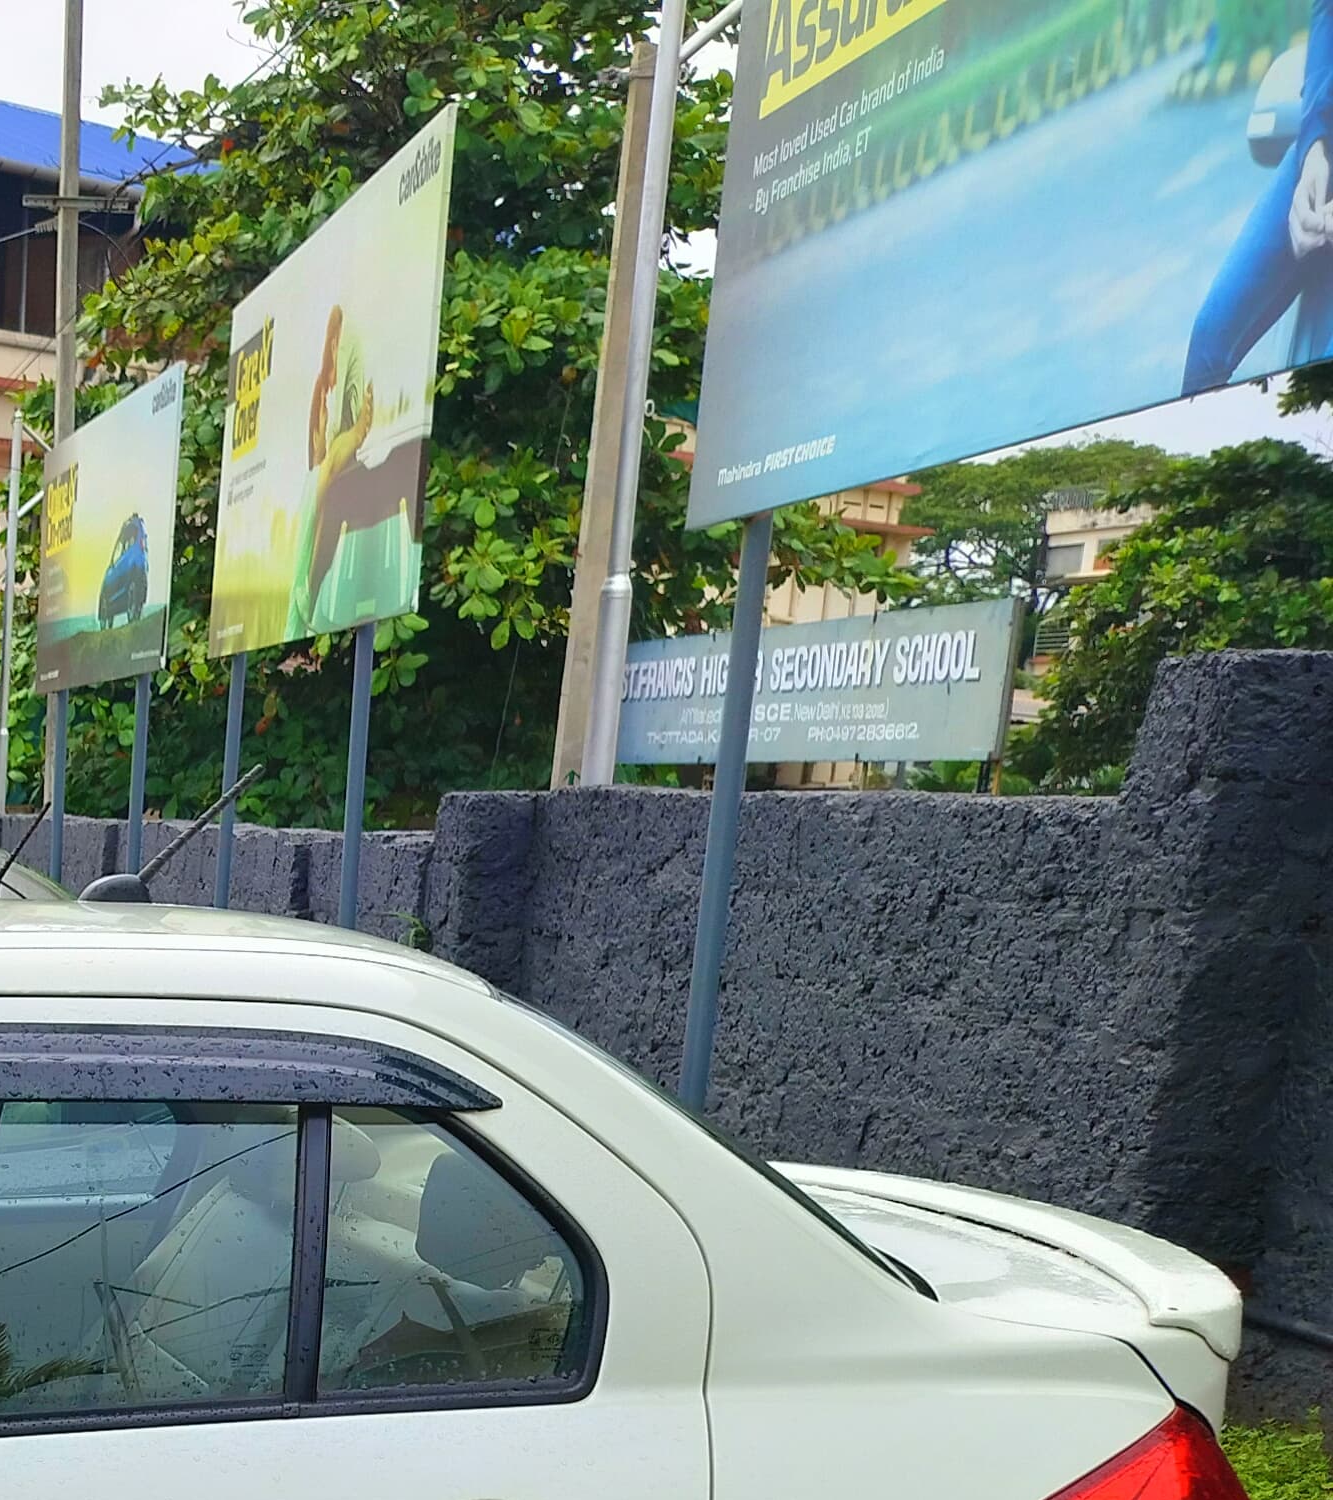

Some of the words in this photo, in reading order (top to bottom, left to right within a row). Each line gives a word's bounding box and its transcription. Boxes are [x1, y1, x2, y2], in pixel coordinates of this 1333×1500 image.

[753, 146, 778, 179] Most
[781, 123, 809, 161] loved
[810, 108, 838, 143] Used
[839, 101, 858, 128] Car
[860, 77, 894, 116] brand
[897, 61, 912, 94] of
[913, 44, 945, 84] India
[755, 184, 769, 215] By
[771, 159, 820, 204] Franchise
[822, 138, 852, 175] India,
[855, 126, 872, 157] ET
[236, 348, 261, 395] Care
[233, 400, 260, 449] Cover
[718, 461, 761, 487] Mahindra
[763, 446, 795, 473] FIRST
[794, 434, 836, 464] CHOICE
[770, 638, 891, 692] SECONDARY
[893, 630, 981, 683] SCHOOL
